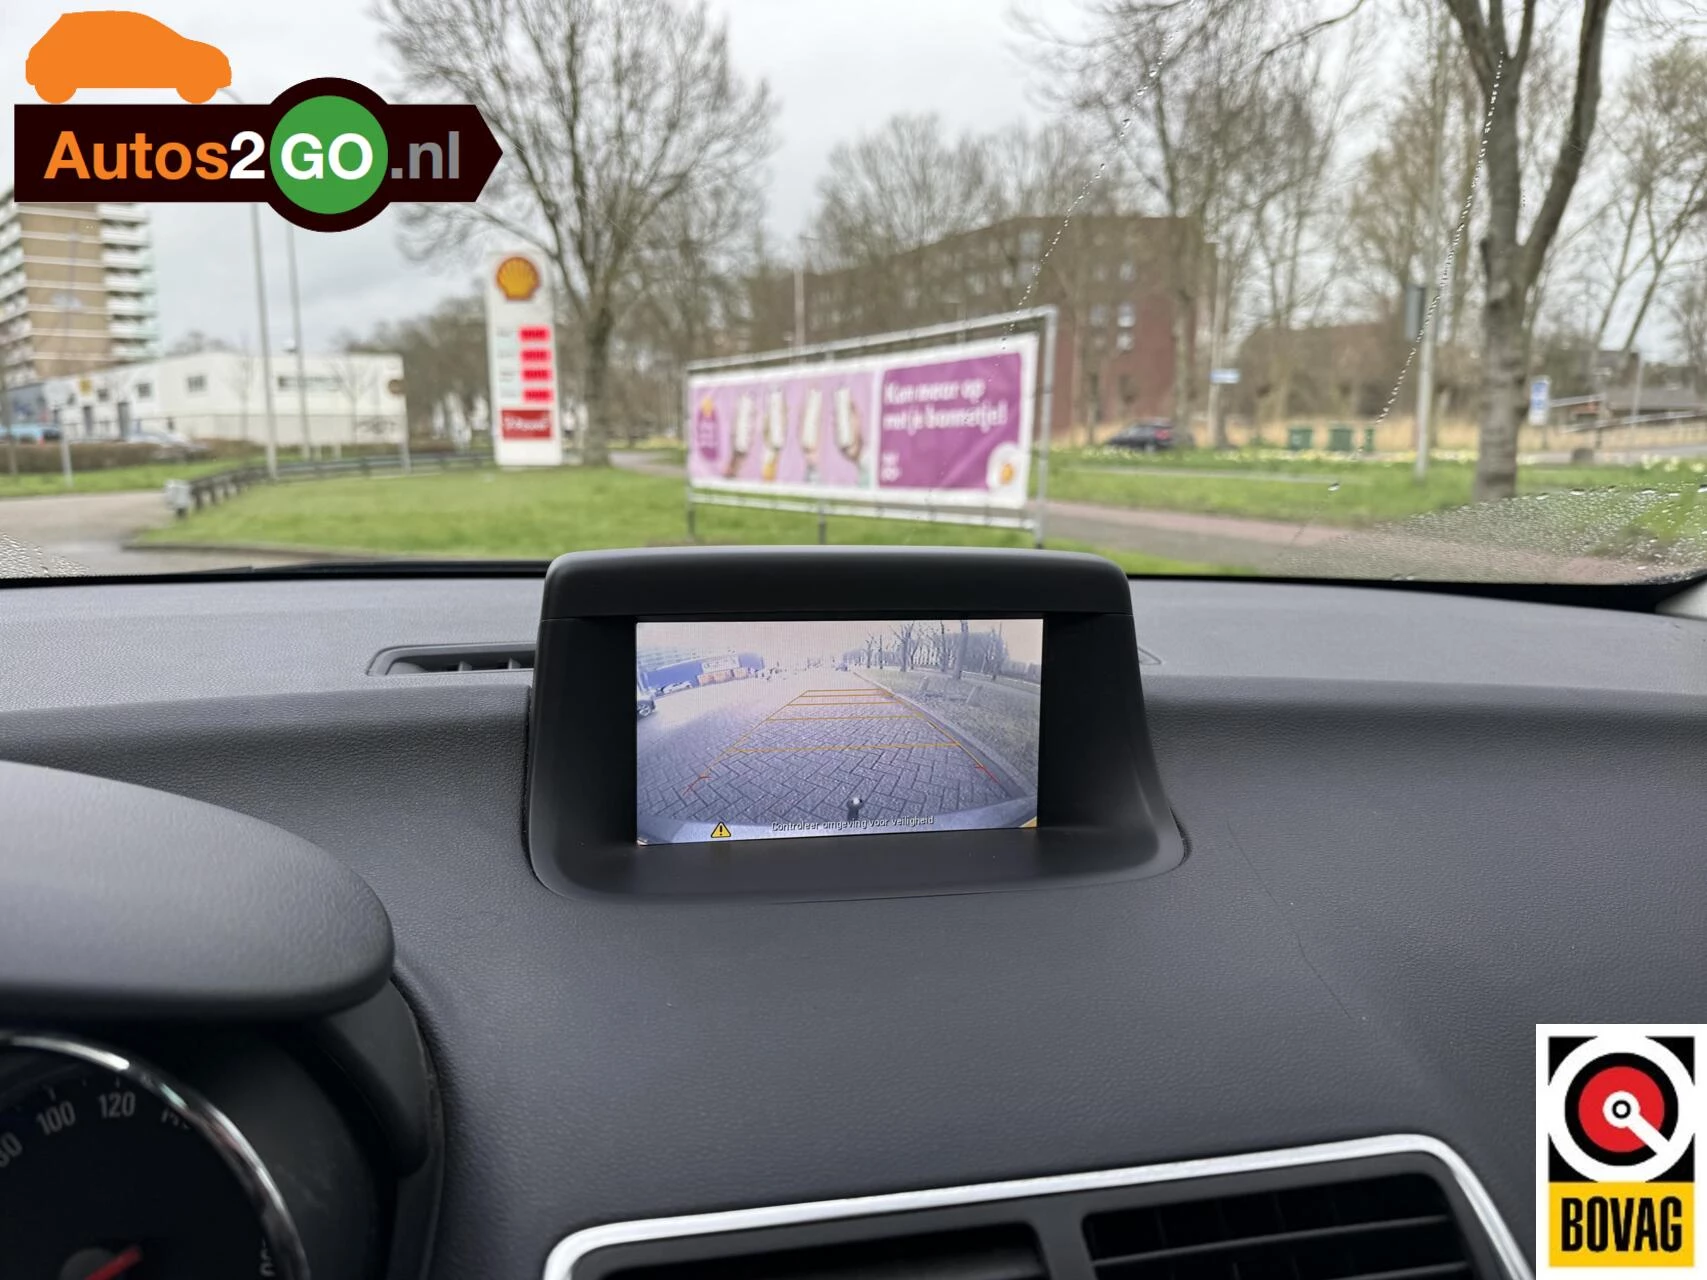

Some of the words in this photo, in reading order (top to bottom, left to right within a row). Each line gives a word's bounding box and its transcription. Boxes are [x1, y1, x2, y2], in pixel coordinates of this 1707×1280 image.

[771, 819, 820, 832] Controleer
[822, 819, 868, 831] omgeving
[868, 817, 889, 828] voor
[891, 815, 934, 828] veiligheid
[36, 1101, 76, 1136] 100
[98, 1091, 136, 1119] 120
